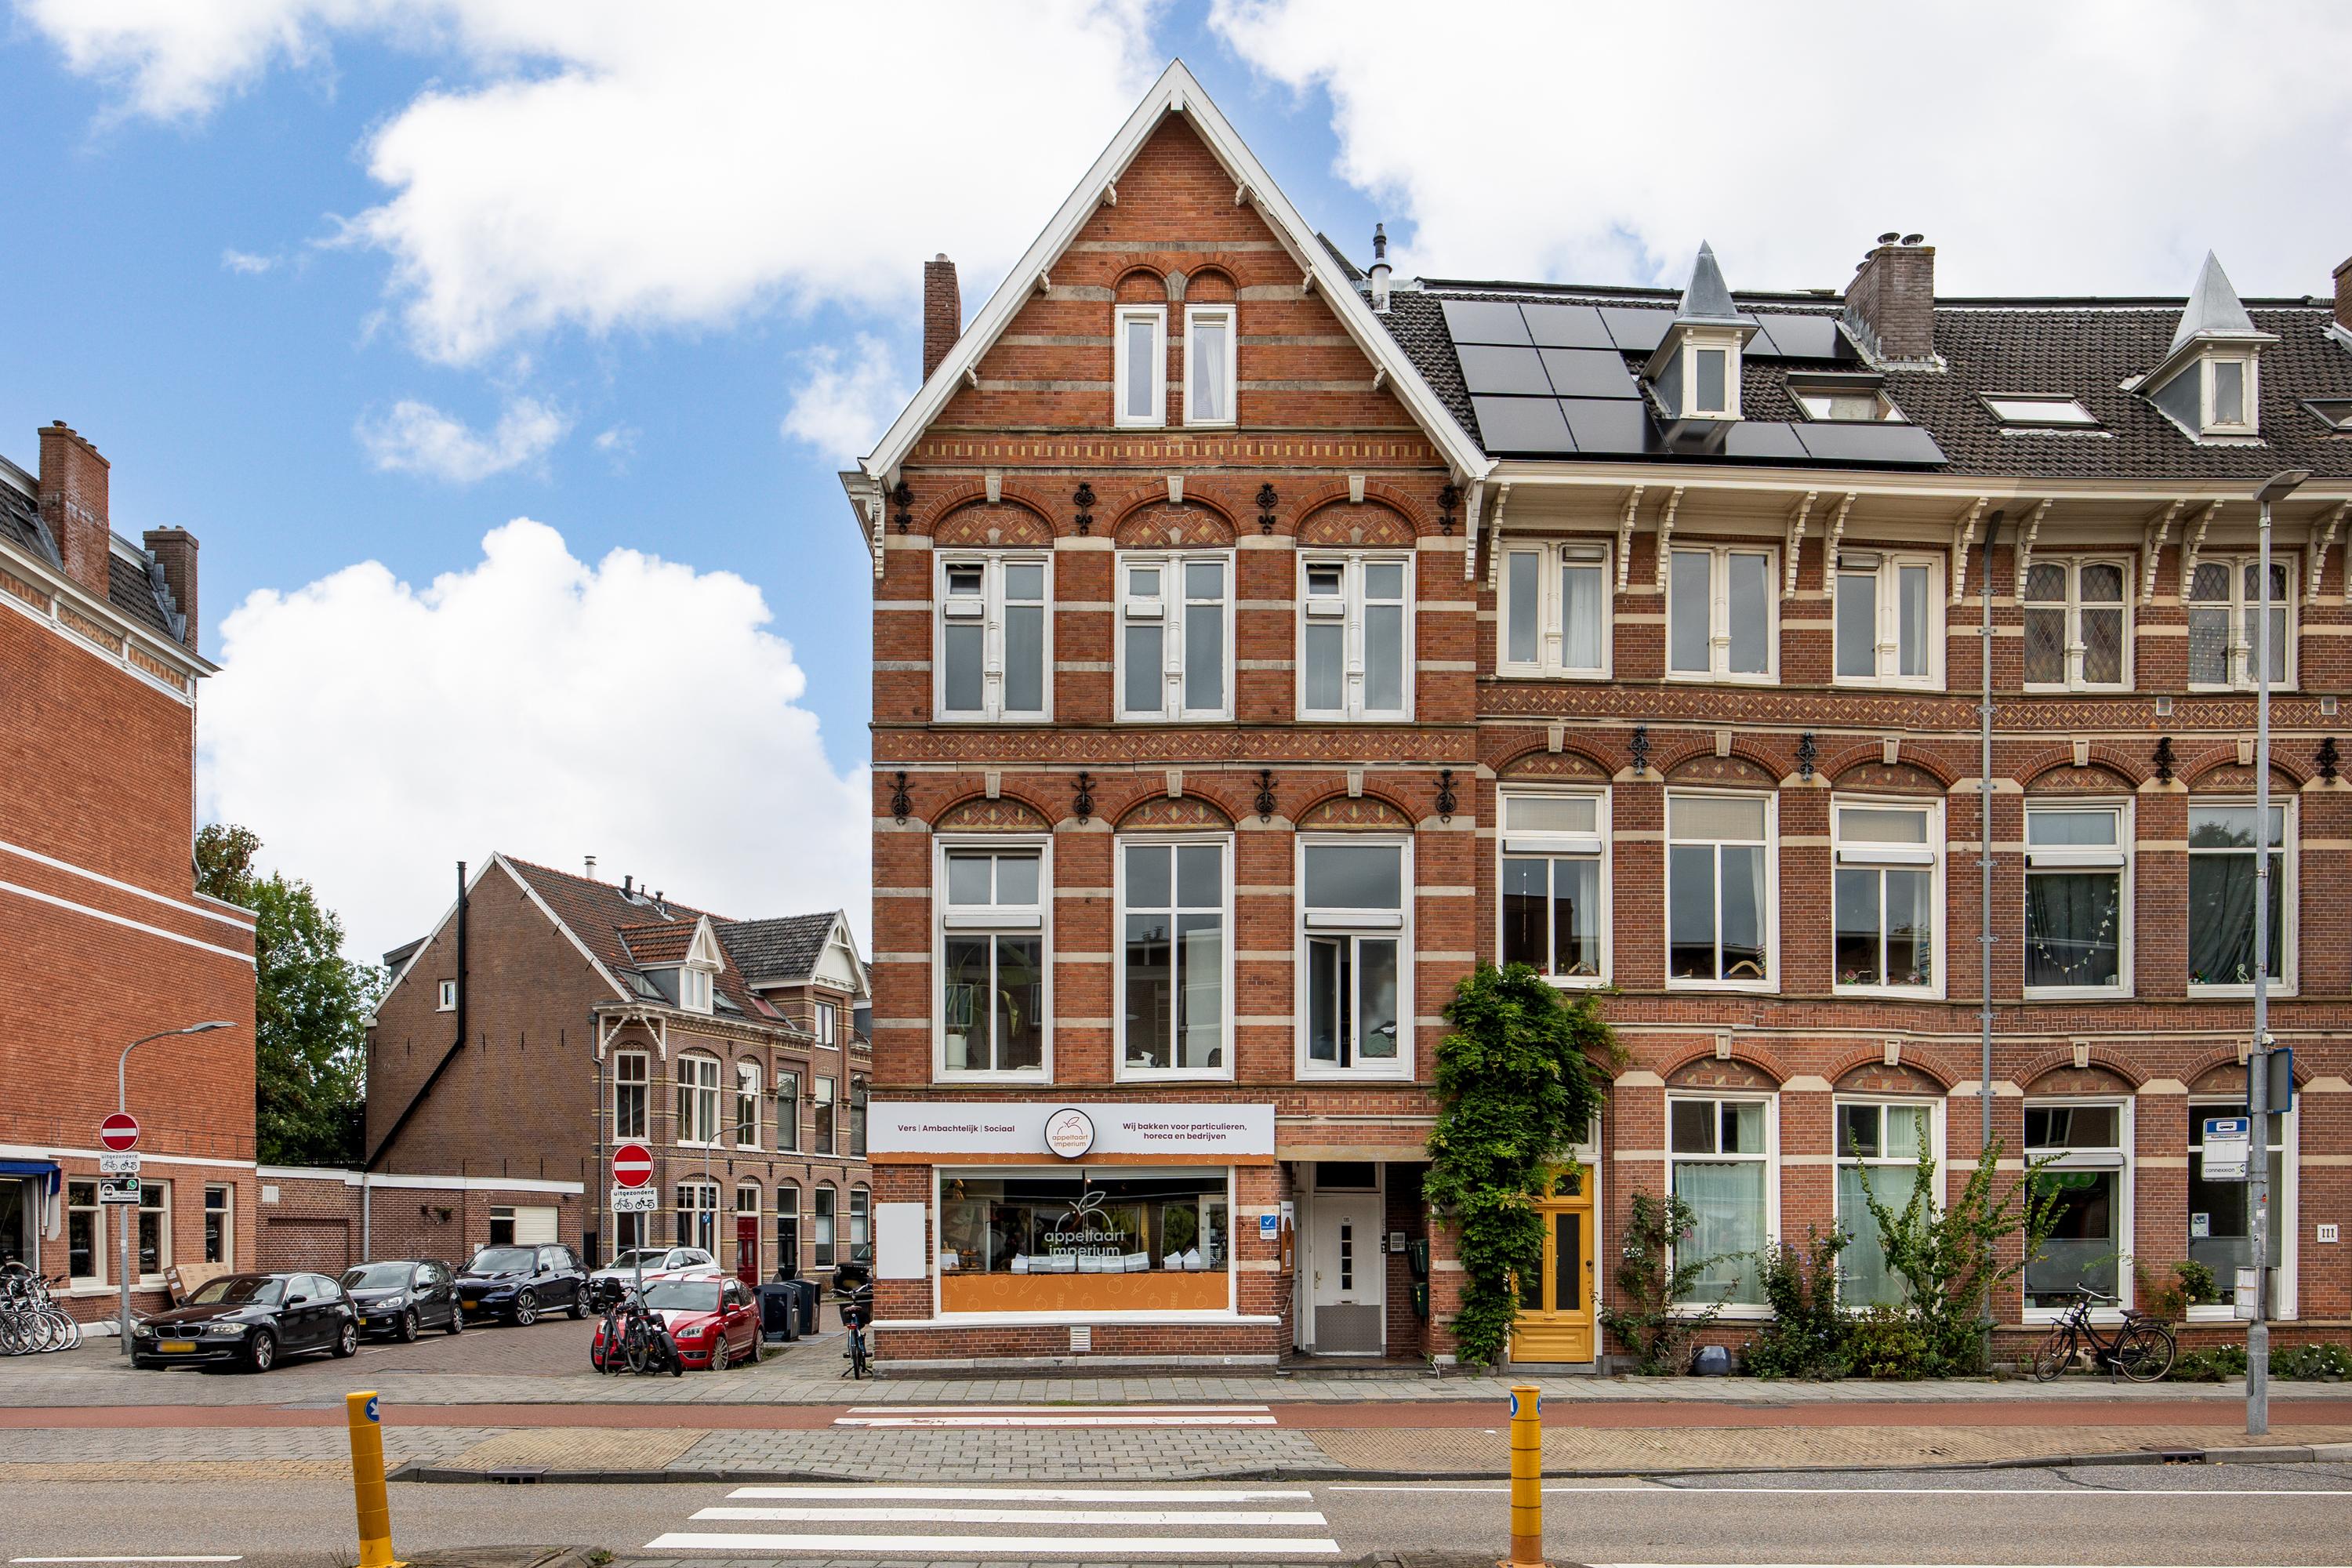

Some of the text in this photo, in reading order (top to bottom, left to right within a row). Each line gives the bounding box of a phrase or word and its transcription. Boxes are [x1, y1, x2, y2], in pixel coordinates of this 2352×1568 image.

[922, 1124, 978, 1134] Ambachtelijk
[1123, 1123, 1136, 1131] Wij
[1191, 1123, 1247, 1131] particulieren,
[1186, 1132, 1226, 1142] bedrijven
[1044, 1229, 1126, 1244] appeltaart
[2321, 1228, 2335, 1238] 111
[1049, 1244, 1120, 1256] imperium
